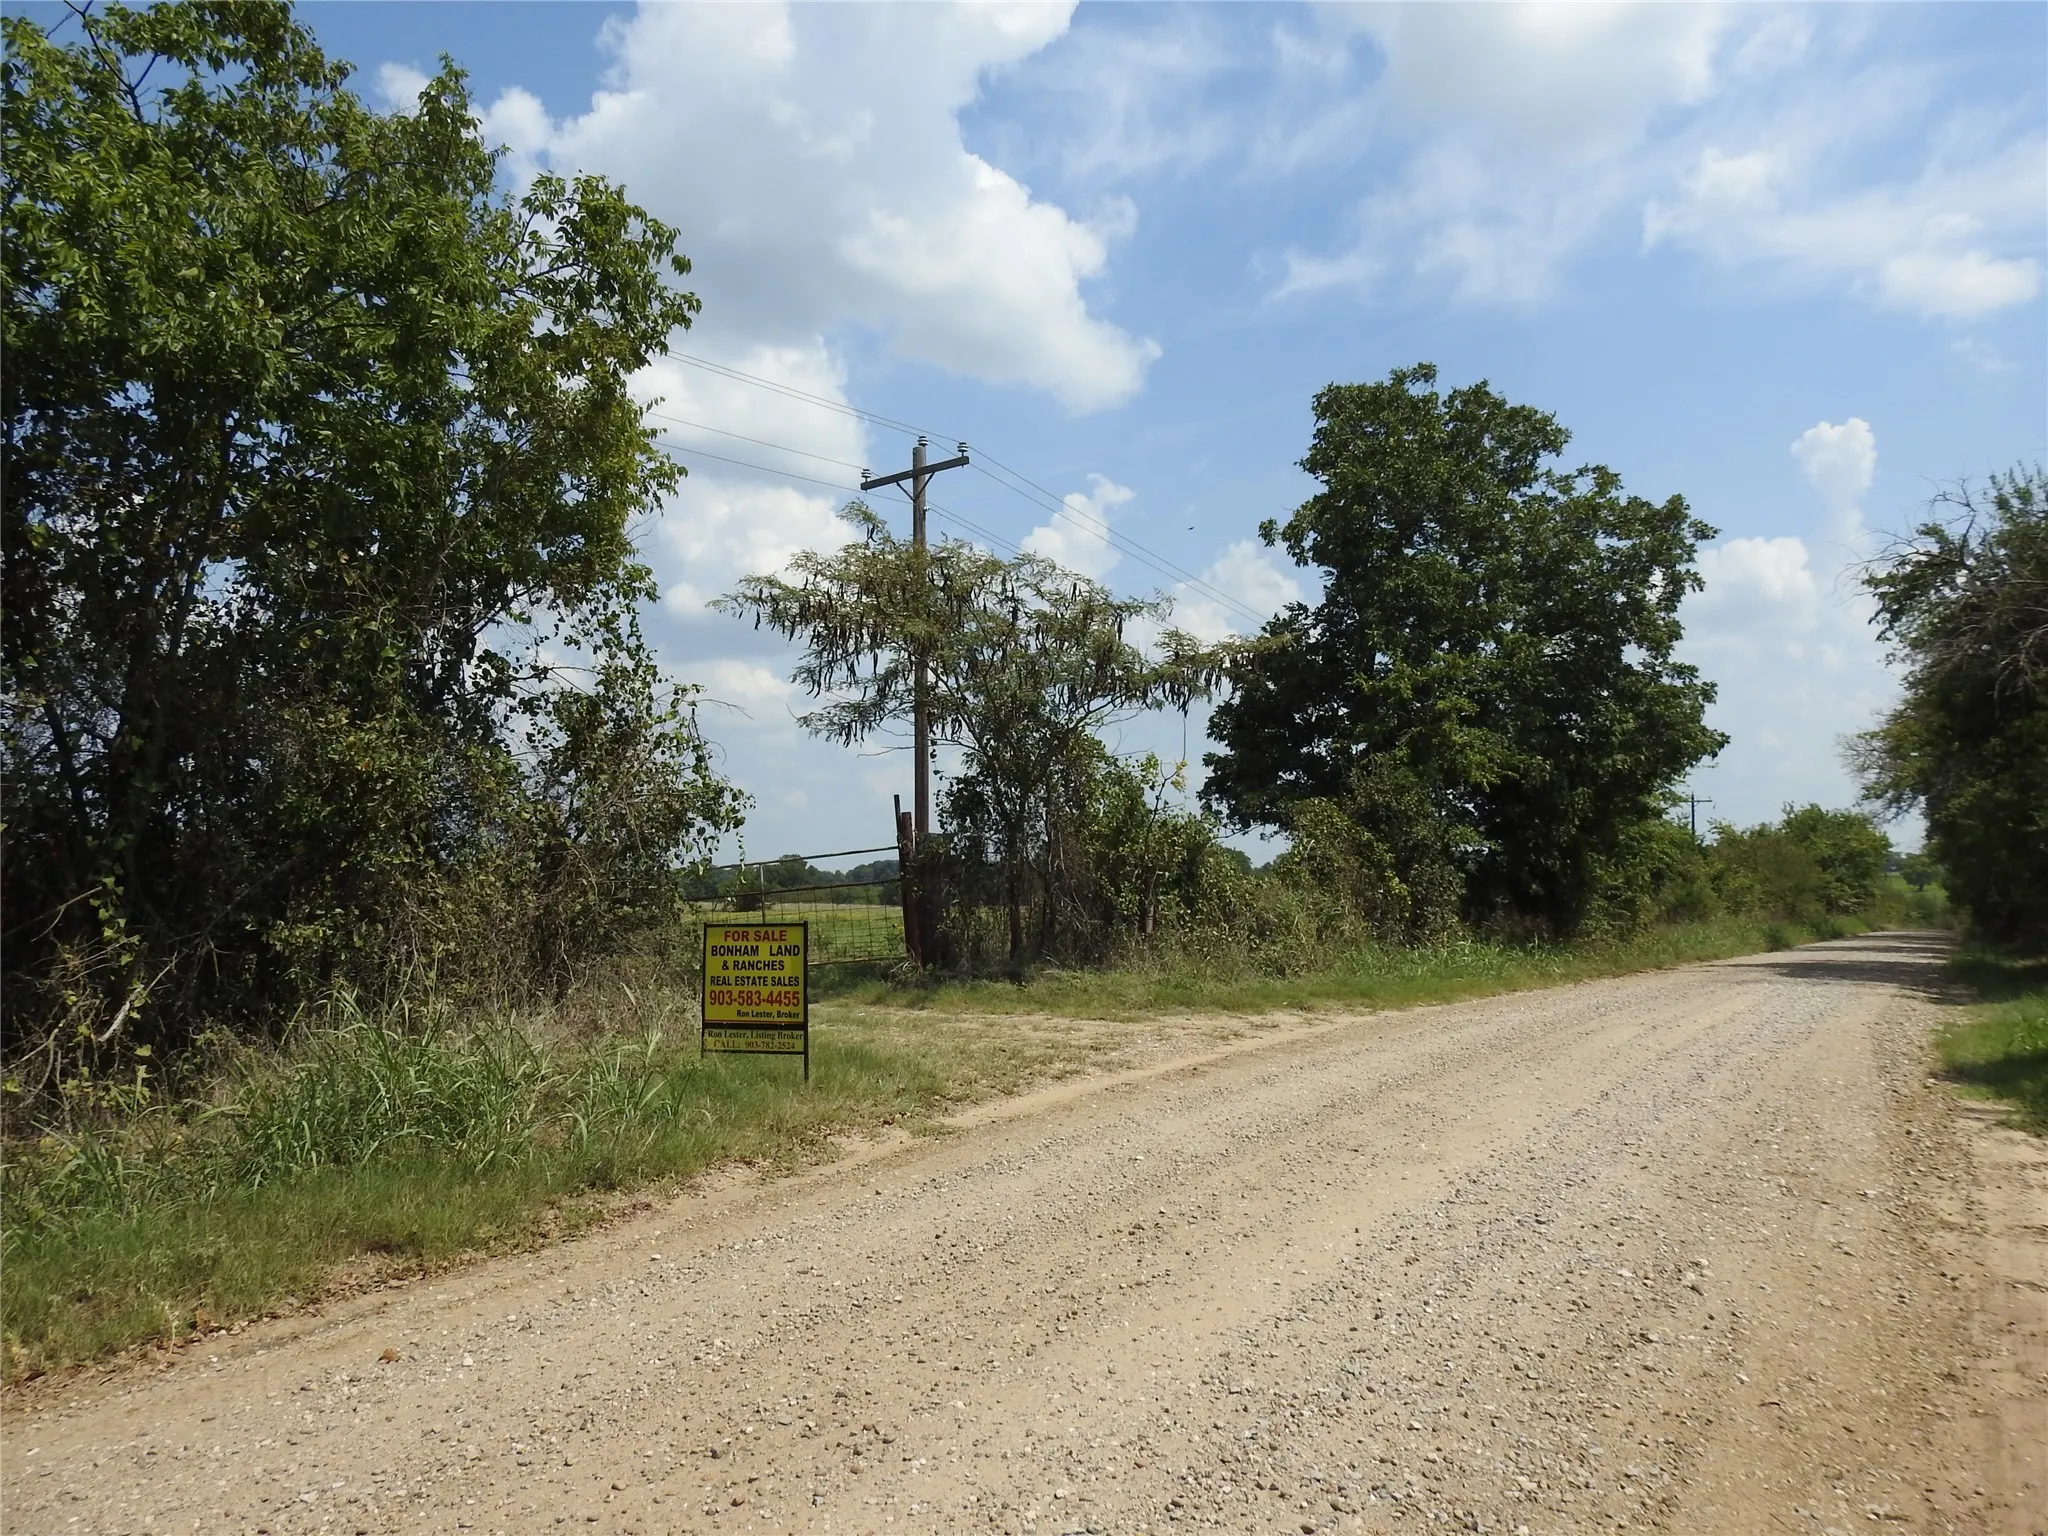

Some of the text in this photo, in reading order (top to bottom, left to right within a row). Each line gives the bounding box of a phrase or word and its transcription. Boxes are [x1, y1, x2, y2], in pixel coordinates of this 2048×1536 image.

[724, 930, 787, 942] FOR SALE
[711, 945, 800, 957] BONHAM LAND
[722, 960, 785, 970] & RANCHES
[710, 976, 800, 986] REAL ESTATE SALES
[709, 990, 800, 1007] 903-583-4455
[751, 1010, 775, 1019] Lester,
[708, 1030, 804, 1040] Ron Lester, Listing Broker
